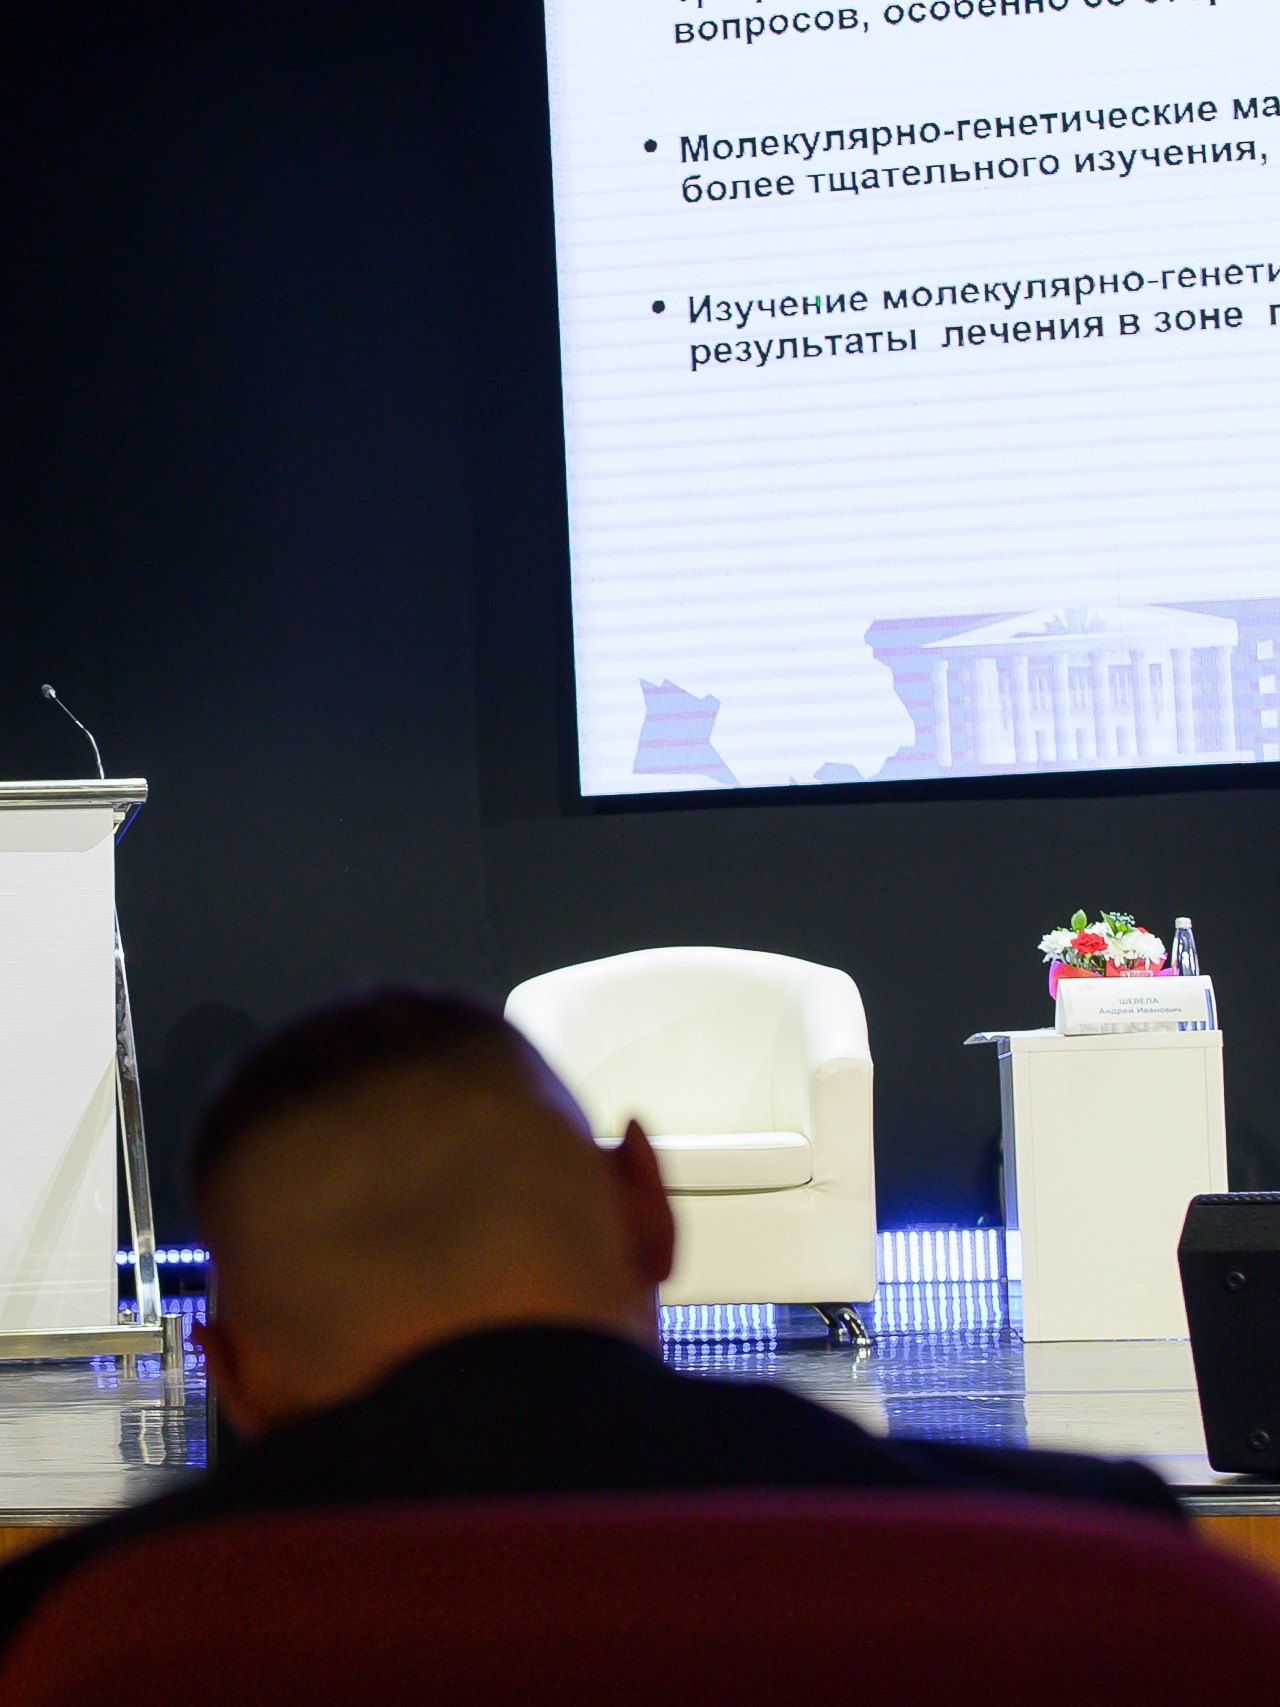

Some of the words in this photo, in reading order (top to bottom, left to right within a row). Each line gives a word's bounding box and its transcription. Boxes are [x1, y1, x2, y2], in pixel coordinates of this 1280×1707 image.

[674, 7, 869, 45] вопросов,
[680, 100, 1218, 163] Молекулярно-генетические
[682, 174, 795, 203] более
[806, 154, 1061, 195] тщательного
[1074, 140, 1268, 178] изучения,
[689, 289, 868, 330] Изучение
[690, 328, 918, 372] результаты
[941, 315, 1105, 348] лечения
[1119, 313, 1141, 336] в
[1154, 306, 1243, 334] зоне
[1098, 1006, 1135, 1016] Андрей
[1136, 1006, 1182, 1015] Иванович
